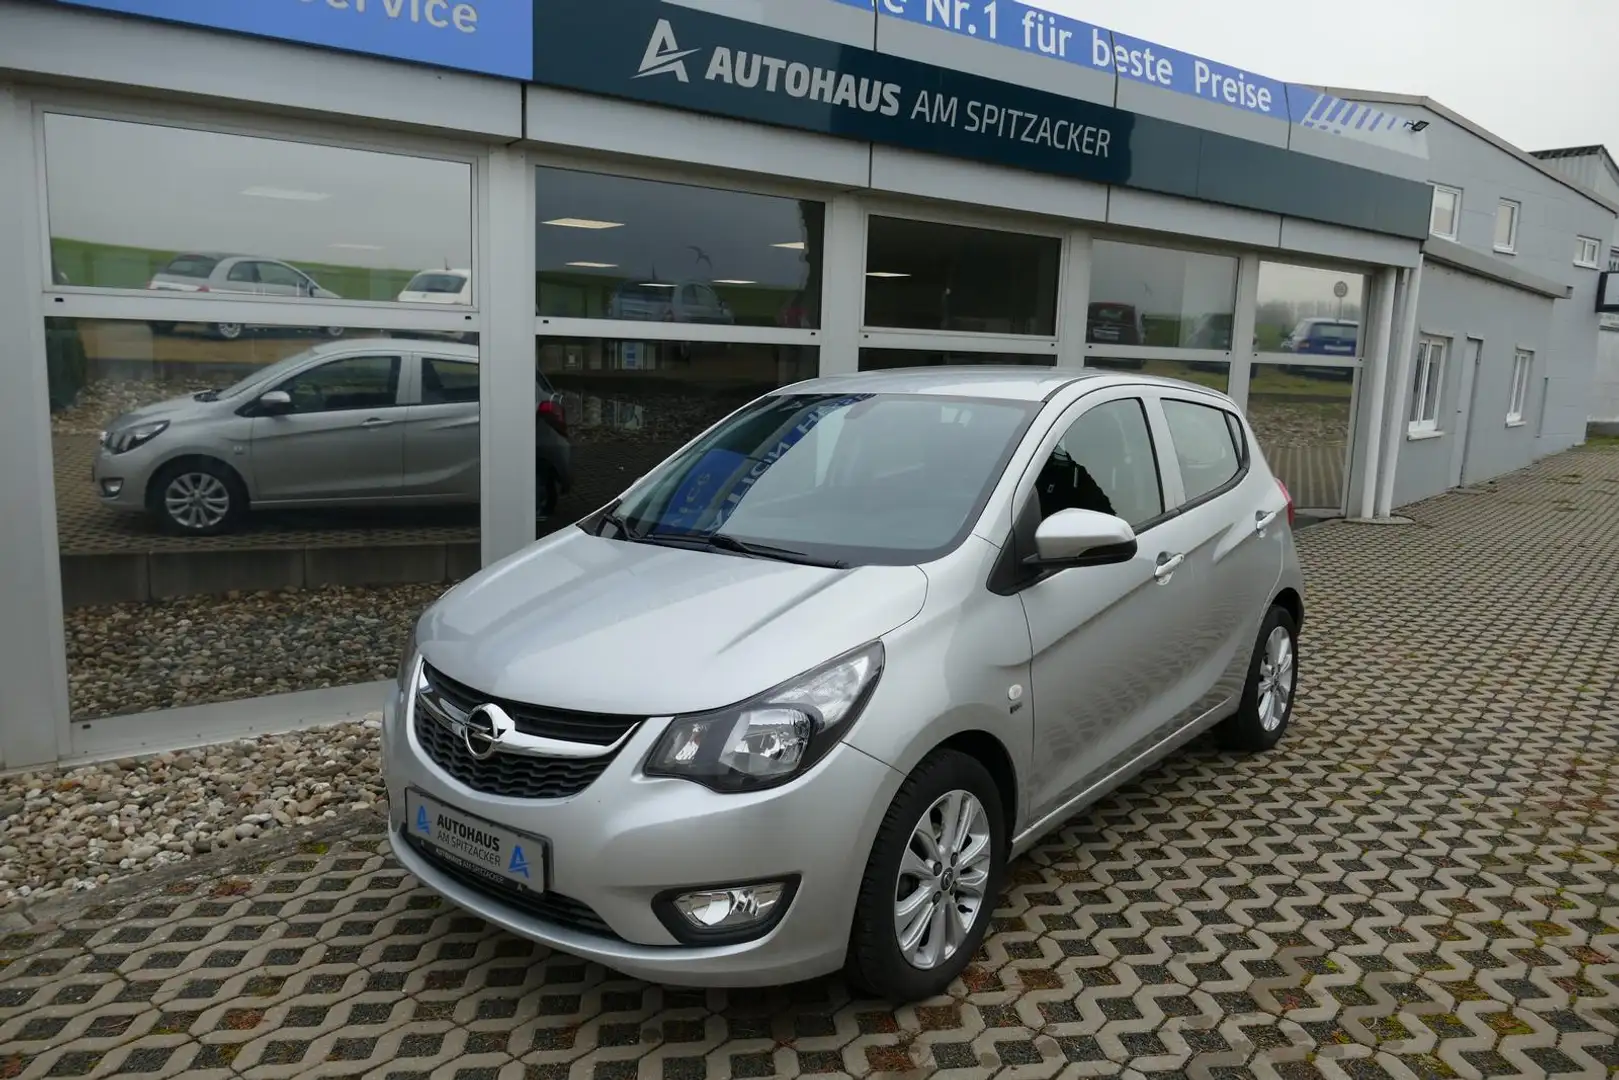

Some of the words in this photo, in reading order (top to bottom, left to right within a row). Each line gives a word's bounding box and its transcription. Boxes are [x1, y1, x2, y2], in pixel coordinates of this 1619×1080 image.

[1022, 10, 1072, 57] für
[1092, 28, 1173, 85] beste
[1195, 61, 1272, 112] Preise
[705, 46, 901, 117] AUTOHAUS
[911, 90, 958, 128] AM
[964, 100, 1111, 158] SPITZACKER
[436, 813, 500, 852] AUTOHAUS
[437, 830, 450, 845] AM
[451, 835, 501, 867] SPITZACKER
